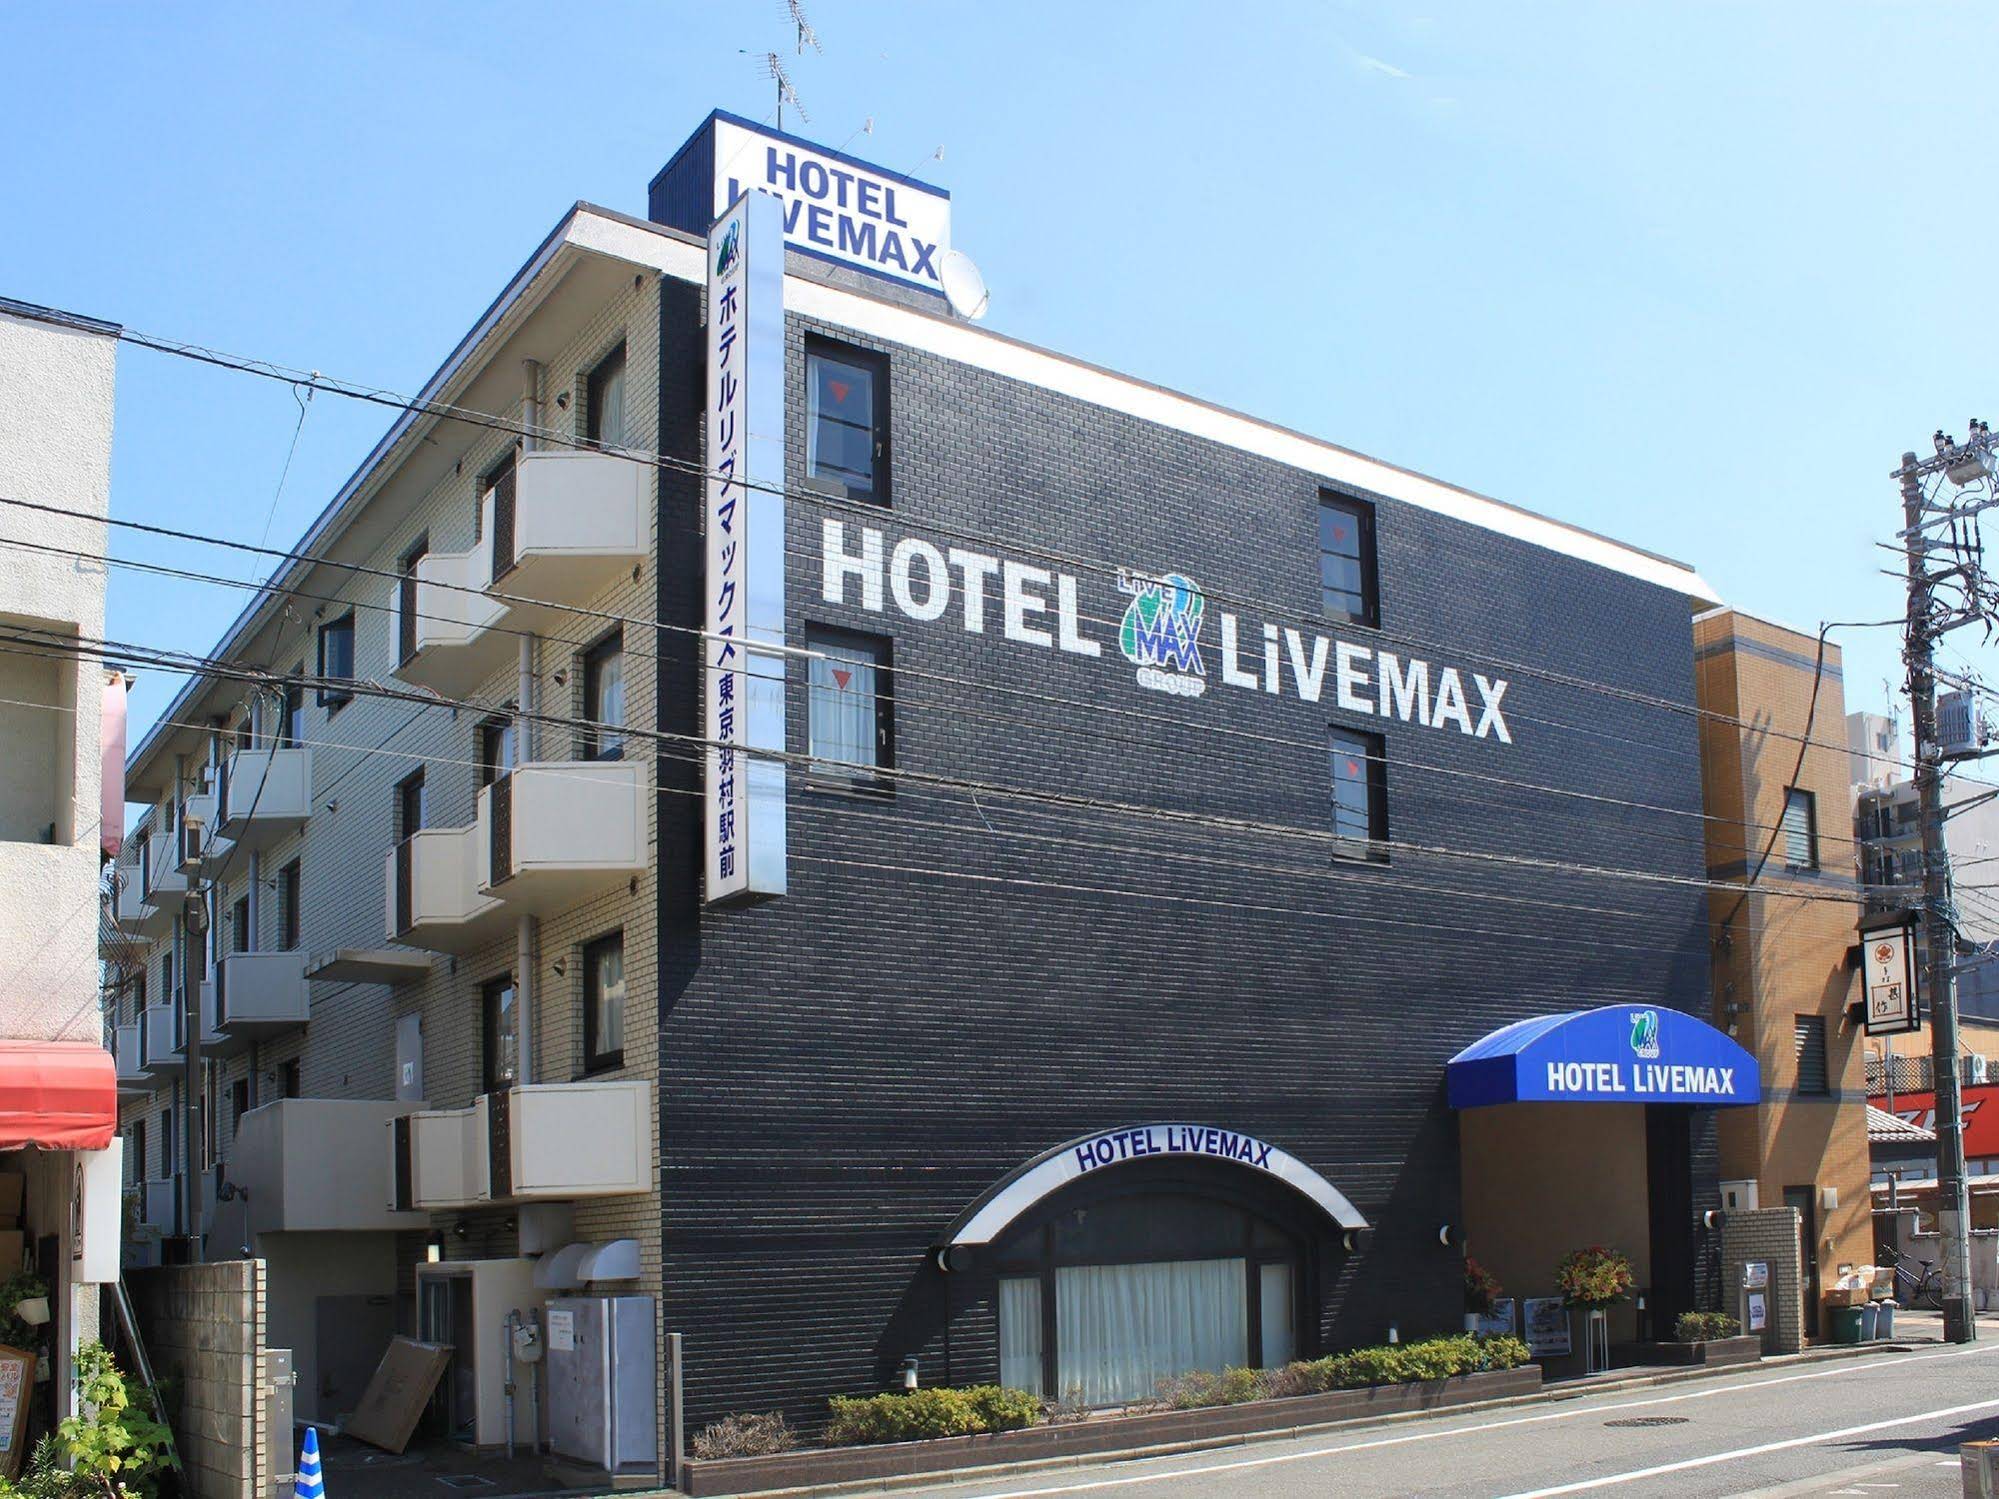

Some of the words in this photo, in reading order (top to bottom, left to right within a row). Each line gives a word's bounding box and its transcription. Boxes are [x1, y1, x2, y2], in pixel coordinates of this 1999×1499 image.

[767, 146, 908, 229] HOTEL
[728, 178, 939, 281] VEMAX
[821, 518, 1101, 658] HOTEL
[1220, 612, 1512, 744] LiVEMAX
[1134, 602, 1206, 676] MAX
[1137, 667, 1206, 697] GROUP
[1547, 1062, 1626, 1092] HOTEL
[1633, 1062, 1735, 1095] LiVEMAX
[1075, 1128, 1162, 1173] HOTEL
[1167, 1127, 1273, 1170] LiVEMAX
